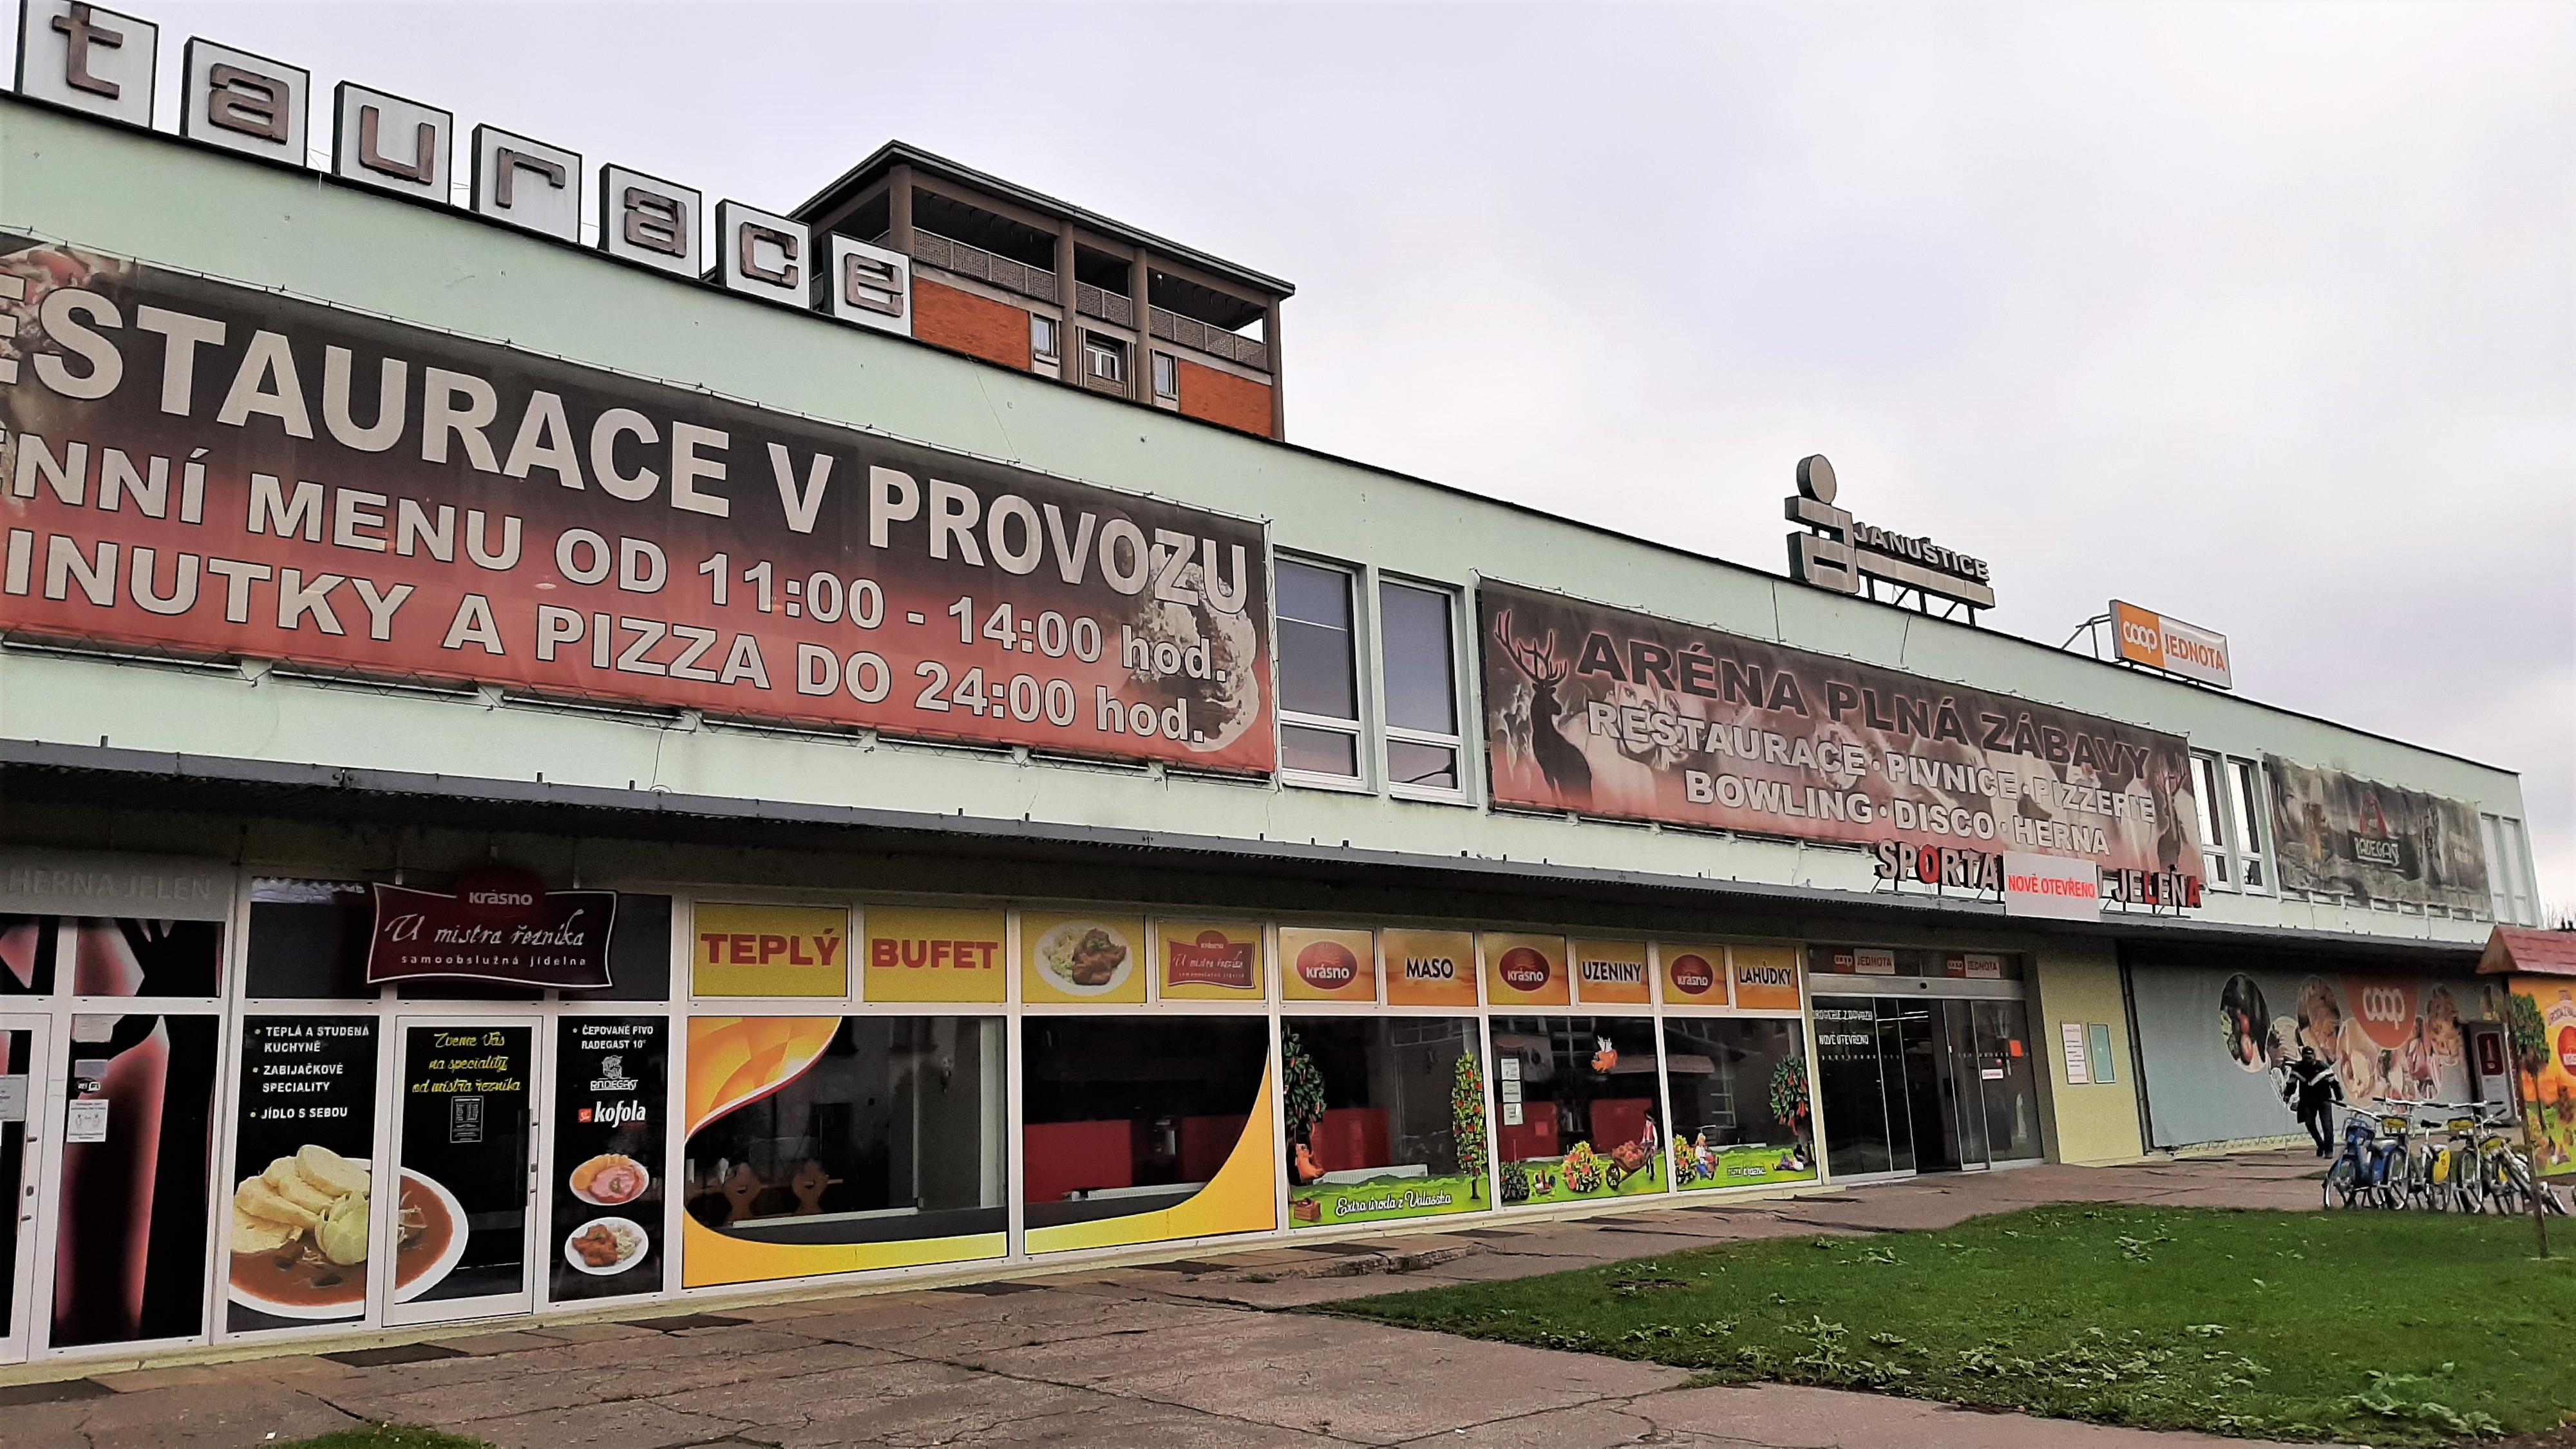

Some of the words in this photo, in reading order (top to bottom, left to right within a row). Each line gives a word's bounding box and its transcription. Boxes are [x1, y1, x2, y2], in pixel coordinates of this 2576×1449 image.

[767, 442, 835, 534] V
[868, 464, 1248, 615] PROVOZU
[247, 472, 522, 571] MENU
[554, 528, 668, 594] OD
[699, 552, 886, 630] 11:00
[948, 596, 1103, 663] 14:00
[1120, 623, 1227, 683] hod.
[5, 527, 415, 641] INUTKY
[442, 593, 505, 656] A
[536, 603, 772, 690] PIZZA
[795, 641, 892, 703] DO
[914, 660, 1077, 727] 24:00
[1096, 685, 1205, 744] hod.
[2123, 620, 2157, 654] coop
[2164, 633, 2226, 672] JEDNOTA
[1576, 632, 1809, 717] ARÉNA
[1825, 681, 1969, 746] PLNÁ
[1980, 712, 2150, 780] ZÁBAVY
[1587, 701, 1866, 777] RESTAURACE
[1886, 751, 2020, 800] PIVNICE
[2032, 776, 2156, 824] PIZZERIE
[1684, 769, 1873, 824] BOWLING
[1893, 798, 1995, 840] DISCO
[2012, 815, 2111, 855] HERNA
[2008, 873, 2039, 893] NOVĚ
[2041, 876, 2096, 898] OTEVŘENO
[384, 913, 425, 942] U
[433, 925, 502, 945] mistra
[511, 909, 585, 946] řezníka
[700, 927, 840, 966] TEPLÝ
[871, 938, 999, 969] BUFET
[401, 954, 519, 965] samoobslužná
[530, 956, 587, 967] jídelna
[1405, 957, 1454, 979] MASO
[1582, 960, 1642, 983] UZENINY
[1738, 961, 1792, 986] LAHŮDKY
[2363, 987, 2406, 1030] coop
[265, 1024, 303, 1037] TEPLÁ
[305, 1027, 314, 1037] A
[317, 1024, 370, 1037] STUDENÁ
[582, 1024, 630, 1036] ČEPOVANÉ
[632, 1025, 654, 1035] PIVO
[582, 1040, 630, 1050] RADEGAST
[263, 1063, 344, 1075] ZABIJAČKOVÉ
[262, 1081, 330, 1093] SPECIALITY
[412, 1079, 430, 1093] od
[260, 1106, 296, 1119] JÍDLO
[298, 1108, 306, 1119] S
[309, 1106, 348, 1118] SEBOU
[594, 1099, 647, 1128] kofola
[1335, 1197, 1367, 1217] Extra
